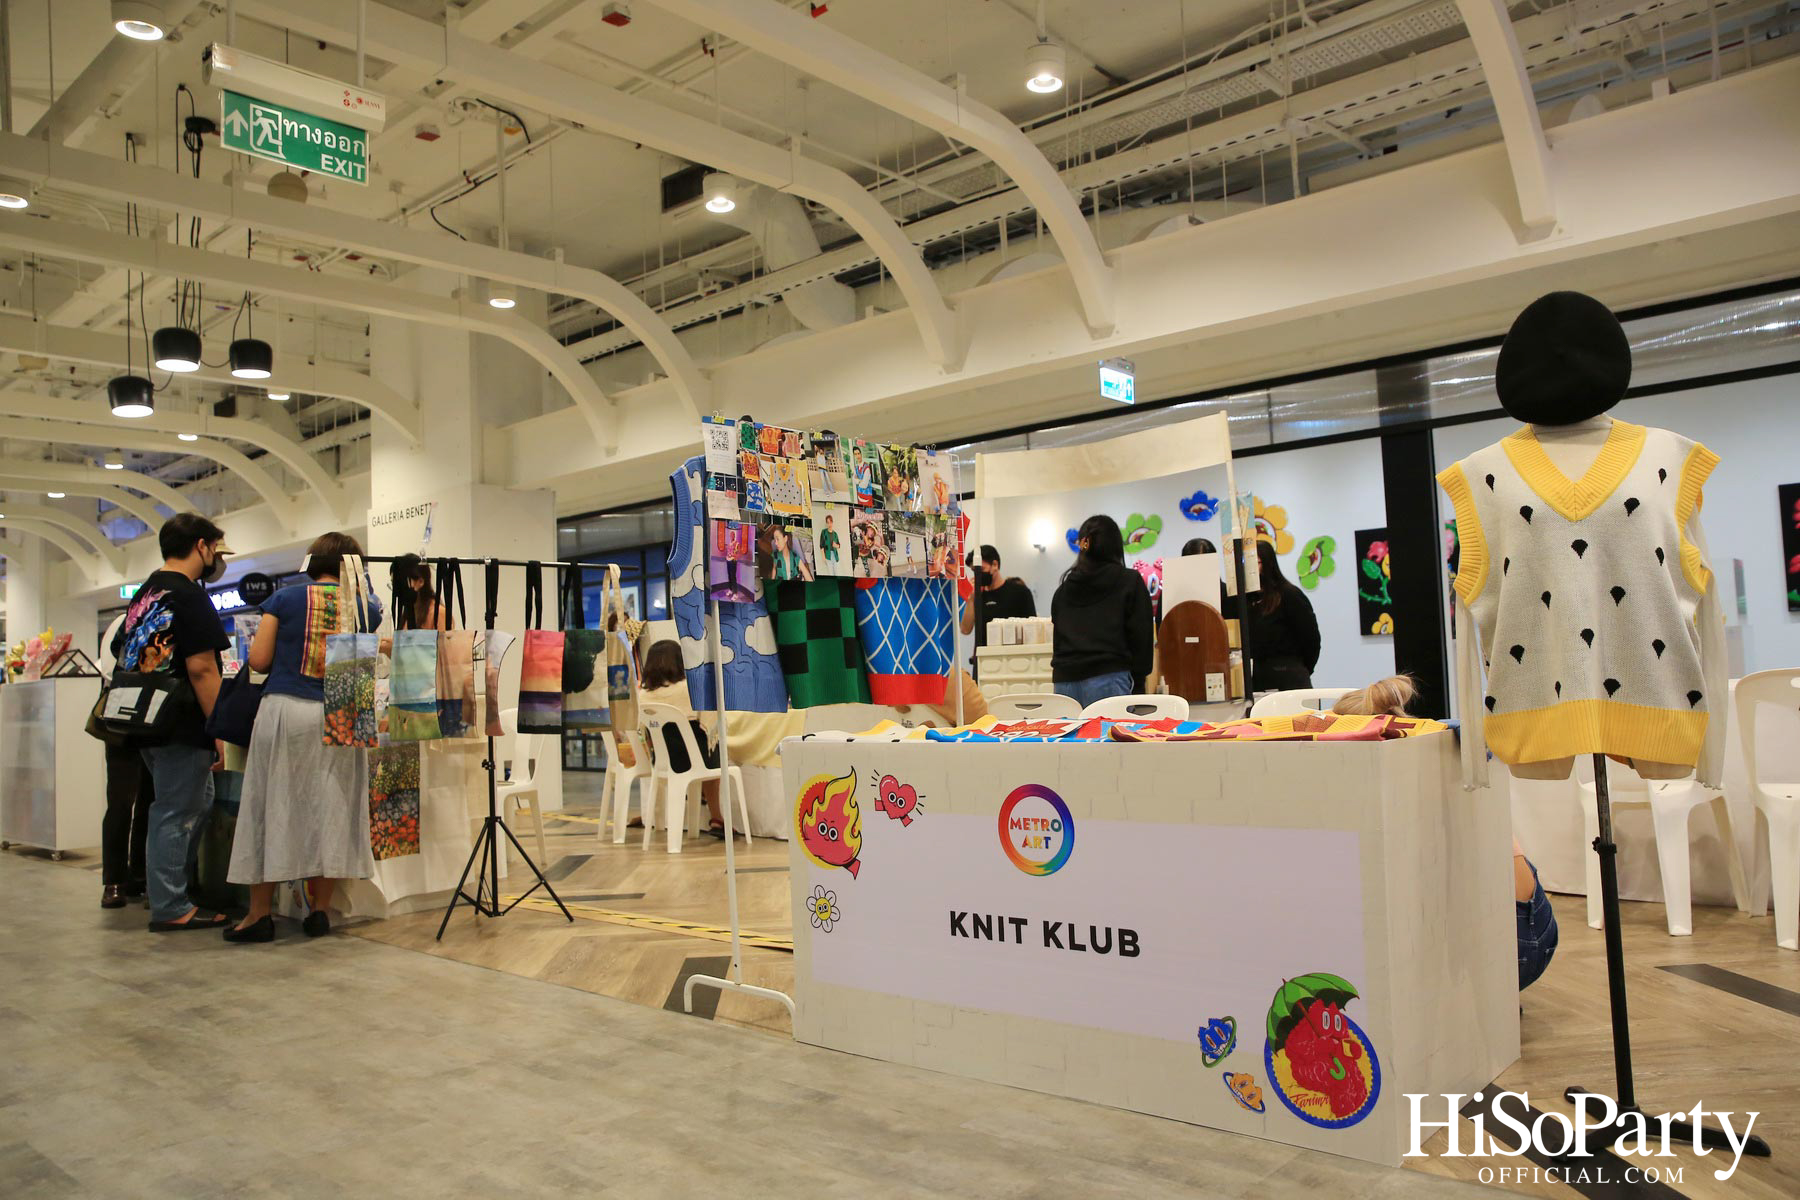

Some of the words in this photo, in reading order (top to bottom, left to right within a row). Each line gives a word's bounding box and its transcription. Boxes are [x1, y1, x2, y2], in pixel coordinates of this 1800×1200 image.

[283, 118, 366, 157] ทางออก
[320, 153, 366, 180] EXIT
[371, 509, 404, 527] GALLERIA
[246, 582, 267, 591] IWS
[1009, 816, 1063, 833] METRO
[1021, 834, 1052, 850] ART
[949, 910, 1029, 945] KNIT
[1042, 920, 1141, 958] KLUB
